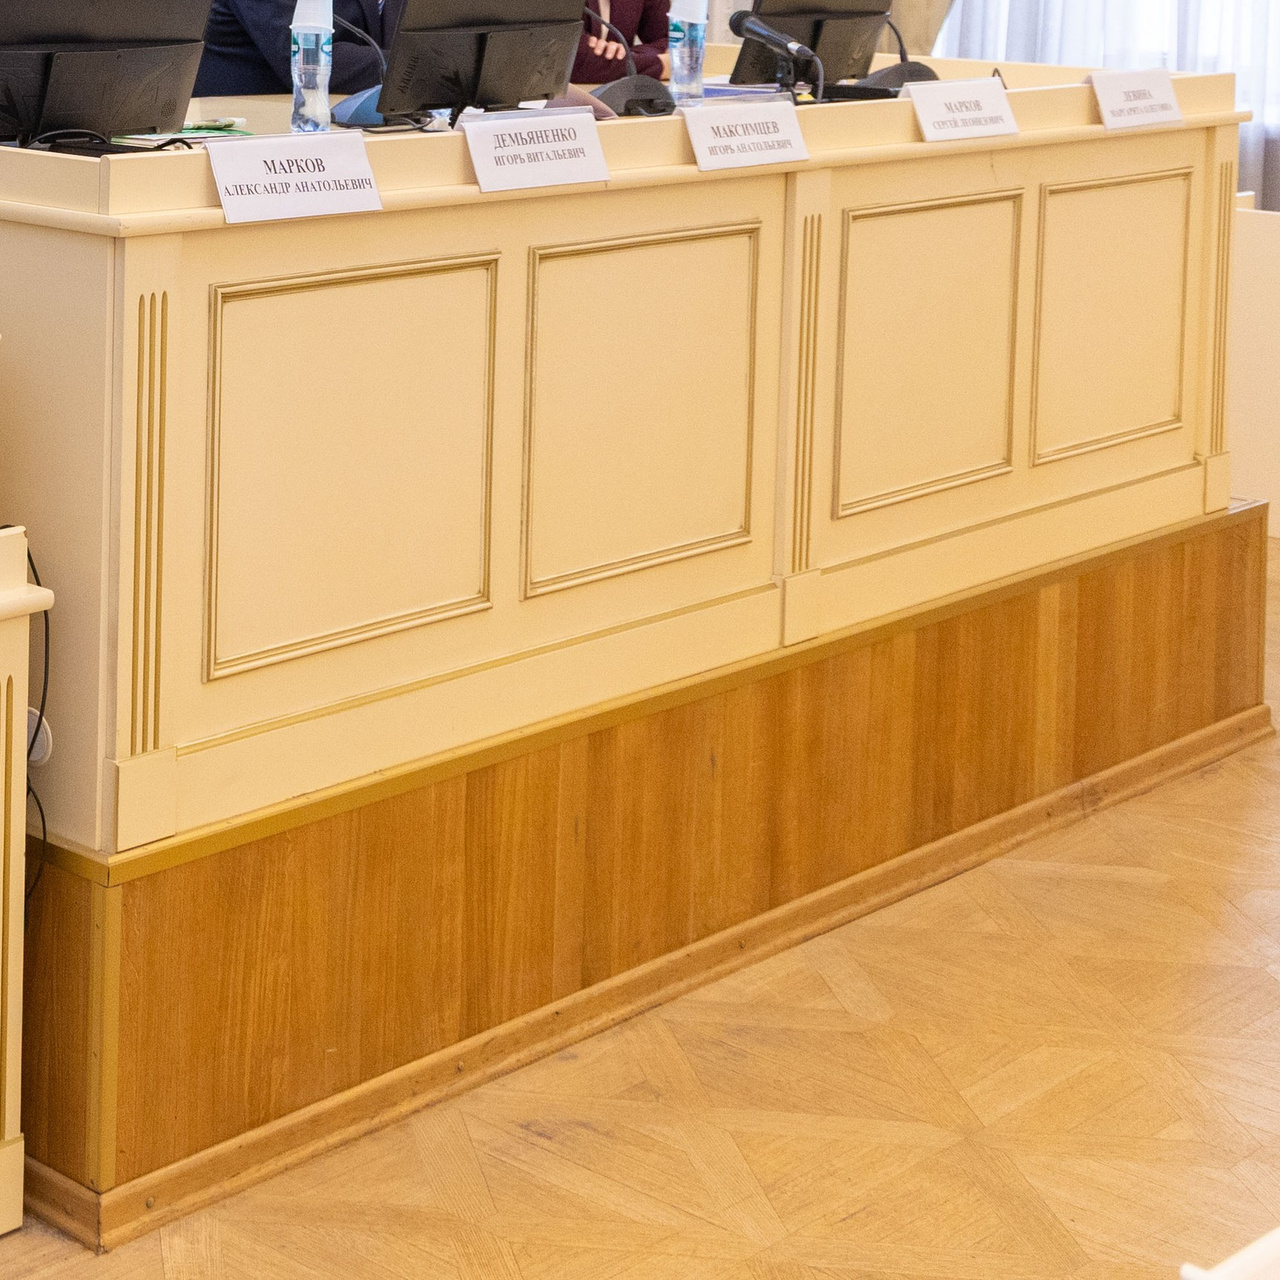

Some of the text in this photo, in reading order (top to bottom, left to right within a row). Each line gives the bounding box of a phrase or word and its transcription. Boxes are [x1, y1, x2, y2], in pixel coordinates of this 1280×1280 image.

[944, 100, 983, 114] МАРКОВ
[493, 127, 577, 150] ДЕМЬЯНЕНКО
[710, 121, 780, 139] МАКСИМЦЕВ
[494, 147, 586, 166] ИГОРЬ ВИТАЛЬЕВИЧ
[707, 139, 793, 156] ИГОРЬ АНАТОЛЬЕВИЧ
[263, 158, 326, 175] МАРКОВ
[224, 178, 373, 197] АЛЕКСАНДР АНАТОЛЬЕВИЧ
